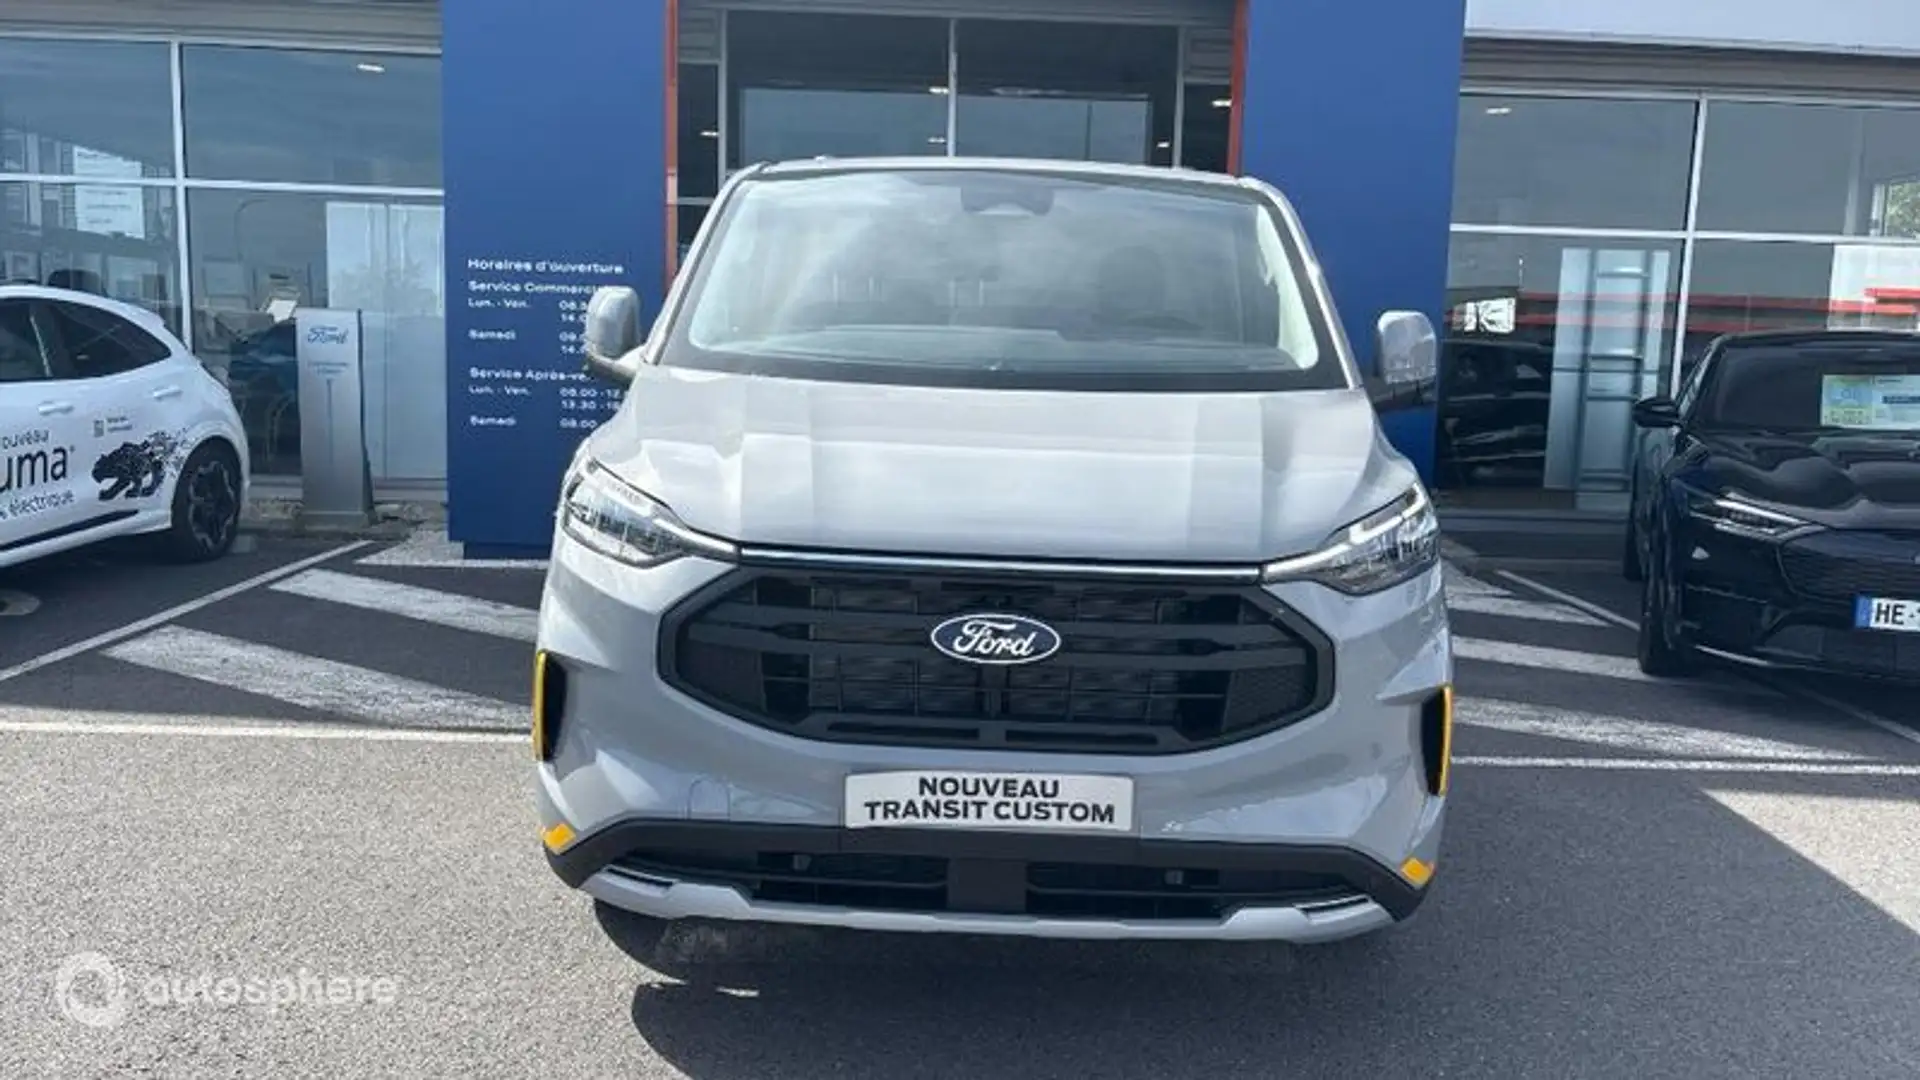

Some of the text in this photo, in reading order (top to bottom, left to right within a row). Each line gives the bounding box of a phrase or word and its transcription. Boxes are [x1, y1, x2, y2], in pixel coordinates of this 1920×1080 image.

[468, 259, 624, 274] Horaires d'ouverture
[468, 280, 597, 295] Service Commerci
[468, 298, 495, 308] Lun.
[503, 299, 530, 309] Ven.
[468, 329, 516, 340] Samedi
[470, 367, 590, 382] Service Après-ve
[468, 384, 494, 394] Lun.
[504, 385, 531, 396] Ven.
[470, 415, 517, 426] Samedi
[0, 429, 49, 450] ouveau
[0, 446, 68, 493] uma
[9, 490, 74, 518] électrique
[1875, 603, 1920, 626] HE-
[952, 618, 1037, 657] Ford
[918, 776, 1060, 799] NOUVEAU
[864, 800, 1115, 824] TRANSIT CUSTOM
